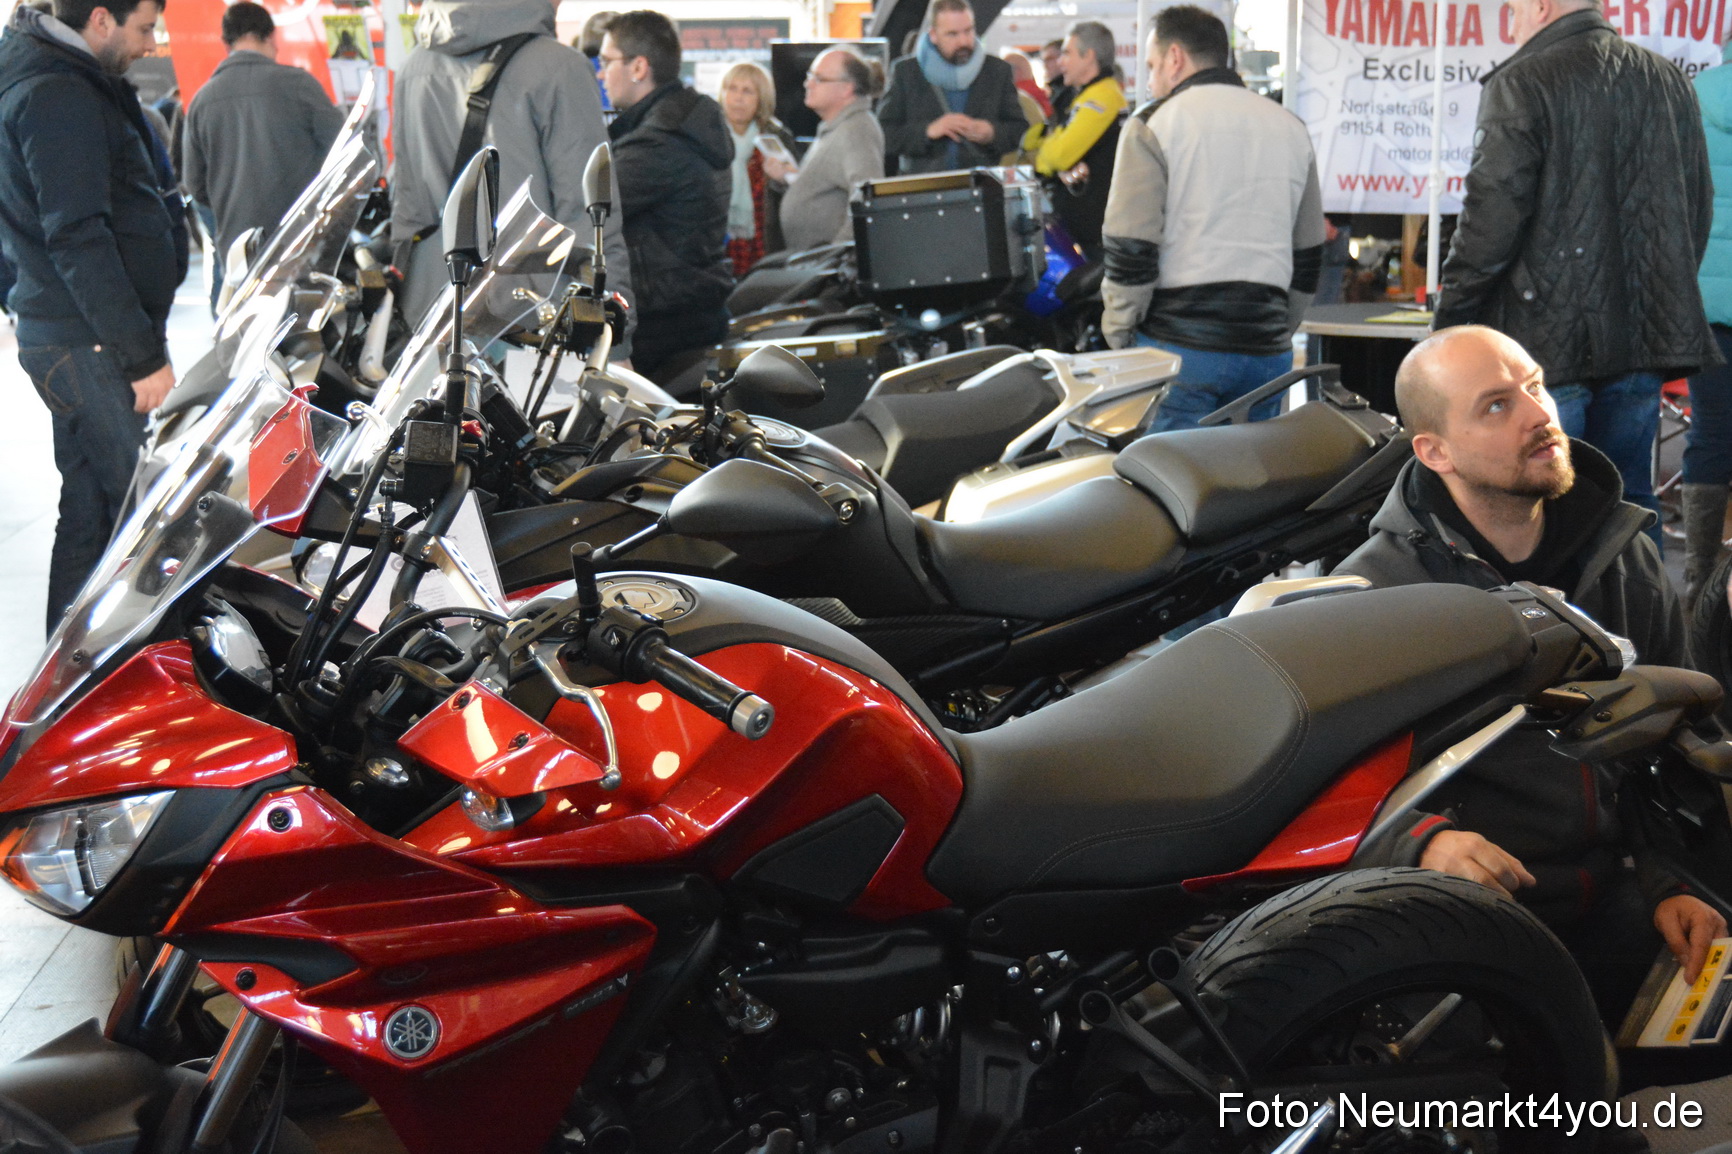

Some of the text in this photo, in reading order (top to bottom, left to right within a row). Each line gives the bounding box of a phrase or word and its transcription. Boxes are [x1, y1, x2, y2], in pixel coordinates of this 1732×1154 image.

[1324, 0, 1484, 47] YAMAHA
[1363, 58, 1480, 82] Exclusiv
[1449, 102, 1459, 117] 9
[1340, 120, 1431, 138] 91154 Roth
